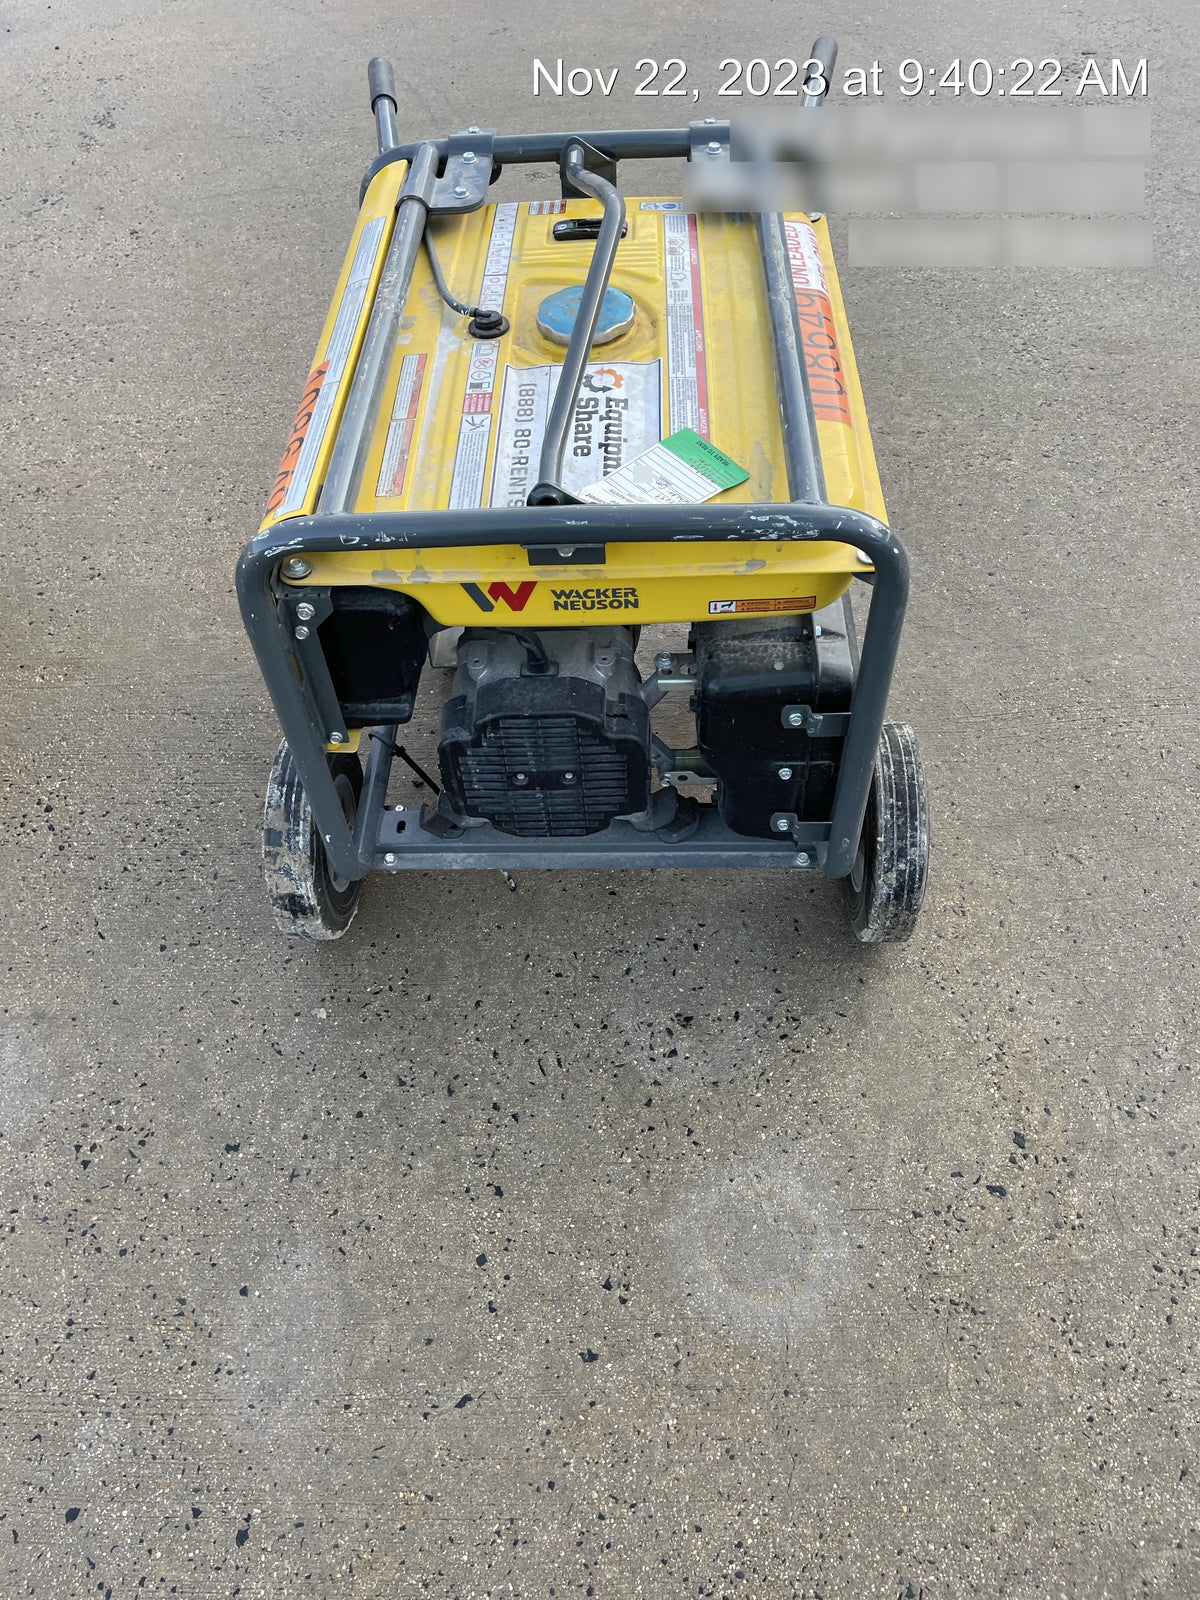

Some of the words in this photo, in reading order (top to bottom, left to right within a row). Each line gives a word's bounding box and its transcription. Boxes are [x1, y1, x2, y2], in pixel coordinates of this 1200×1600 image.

[785, 225, 810, 285] UNLEADED
[515, 383, 537, 423] (888)
[573, 397, 599, 457] Share
[696, 440, 709, 451] RENT
[713, 453, 730, 467] READY
[551, 588, 638, 599] WACKER
[553, 598, 639, 611] NEUSON
